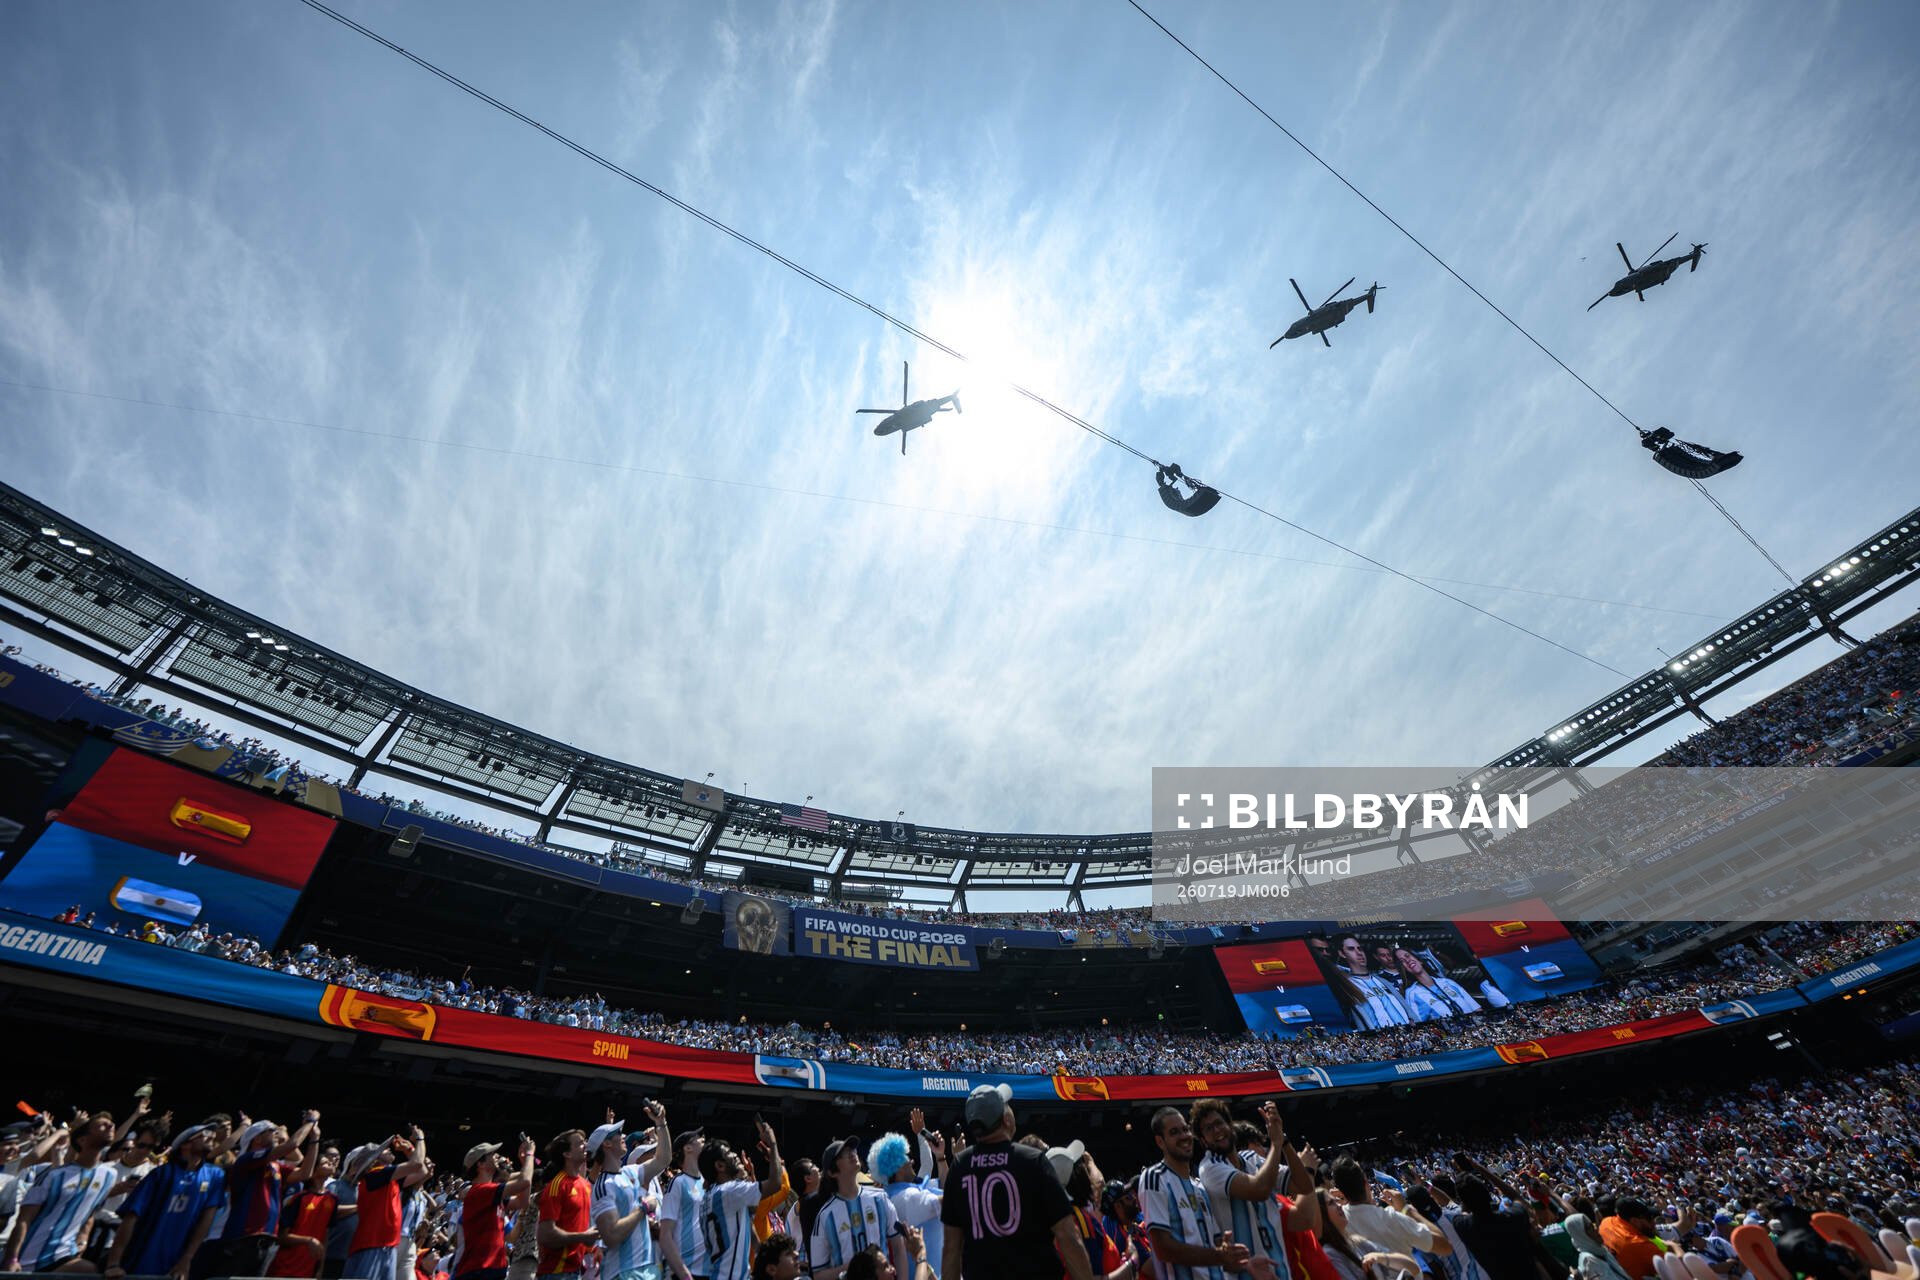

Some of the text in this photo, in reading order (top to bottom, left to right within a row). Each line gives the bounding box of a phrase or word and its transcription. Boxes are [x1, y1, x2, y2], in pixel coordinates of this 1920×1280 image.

[1644, 848, 1672, 864] NEW
[1673, 832, 1708, 851] YORK
[805, 917, 967, 945] FIFA WORLD CUP 2026
[805, 930, 971, 967] THE FINAL
[1830, 962, 1882, 988] ARGENTINA
[592, 1039, 630, 1061] SPAIN
[1394, 1060, 1434, 1075] ARGENTINA
[922, 1077, 970, 1092] ARGENTINA
[1186, 1079, 1209, 1092] SPAIN
[970, 1152, 1009, 1168] MESSI
[961, 1169, 1022, 1241] 10
